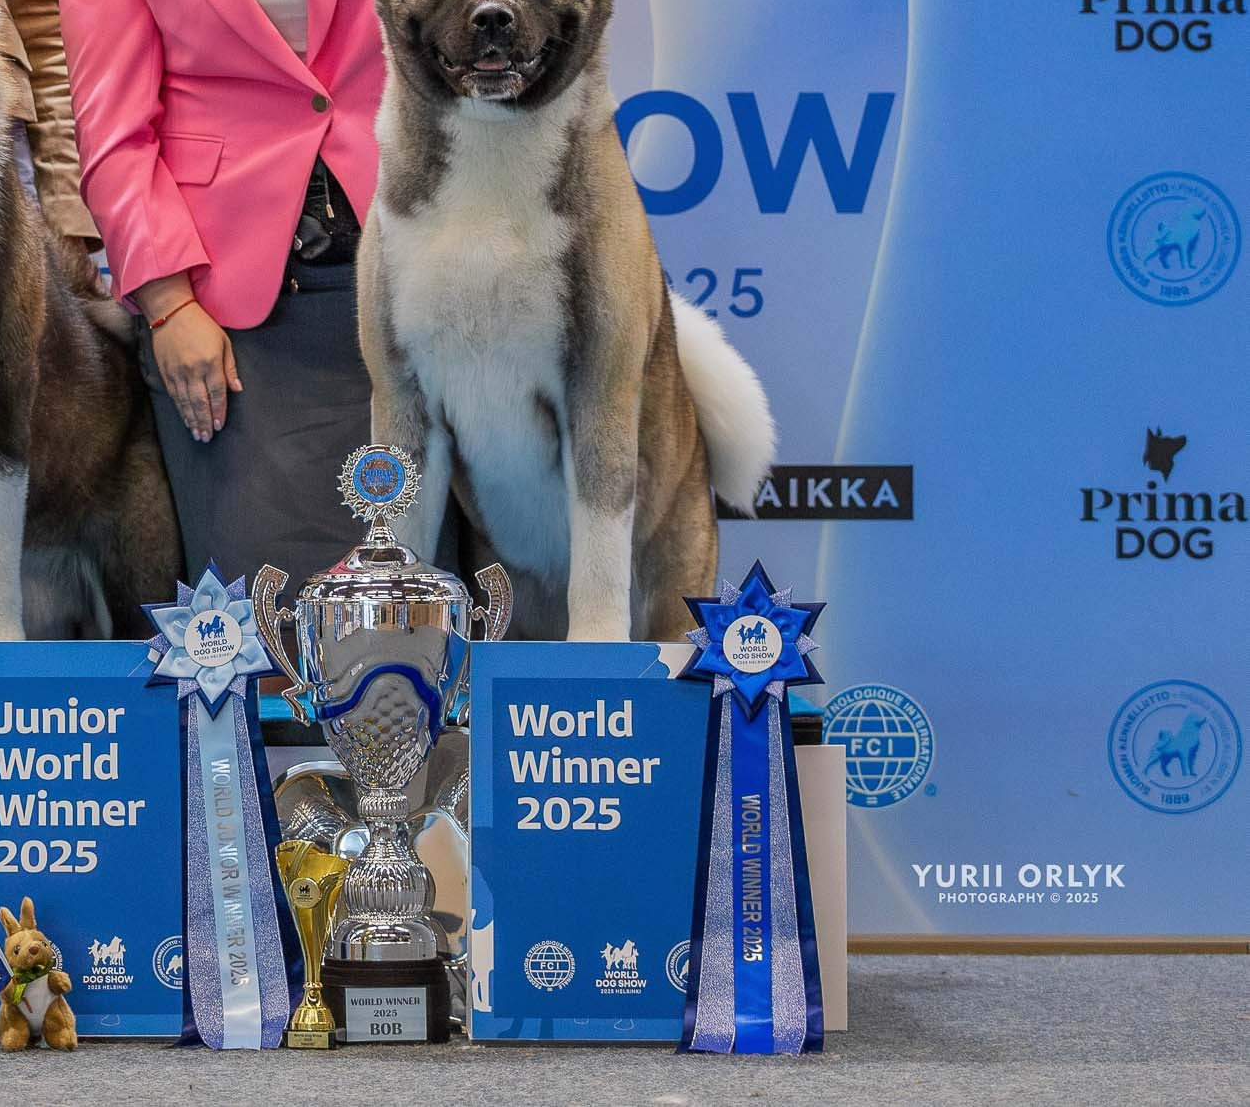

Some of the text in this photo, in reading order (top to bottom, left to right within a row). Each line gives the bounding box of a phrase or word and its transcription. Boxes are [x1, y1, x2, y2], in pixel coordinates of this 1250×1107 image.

[1116, 20, 1213, 52] DOG
[613, 90, 896, 216] OW
[664, 266, 764, 318] 25
[756, 477, 899, 508] AIKKA
[1079, 481, 1249, 522] Prima
[1116, 527, 1213, 559] DOG
[194, 645, 234, 656] DOG SHOW
[200, 639, 227, 648] WORLD
[509, 700, 633, 737] World
[851, 738, 894, 756] FCI
[509, 747, 660, 784] Winner
[518, 797, 621, 830] 2025
[211, 758, 250, 987] WORLD JUNIOR WINNER 2025
[741, 795, 762, 962] WORLD WINNER 2025
[540, 962, 559, 970] FCI
[604, 971, 638, 979] WORLD
[351, 997, 420, 1005] WORLD WINNER
[373, 1009, 397, 1017] 2025
[370, 1022, 402, 1035] BOB
